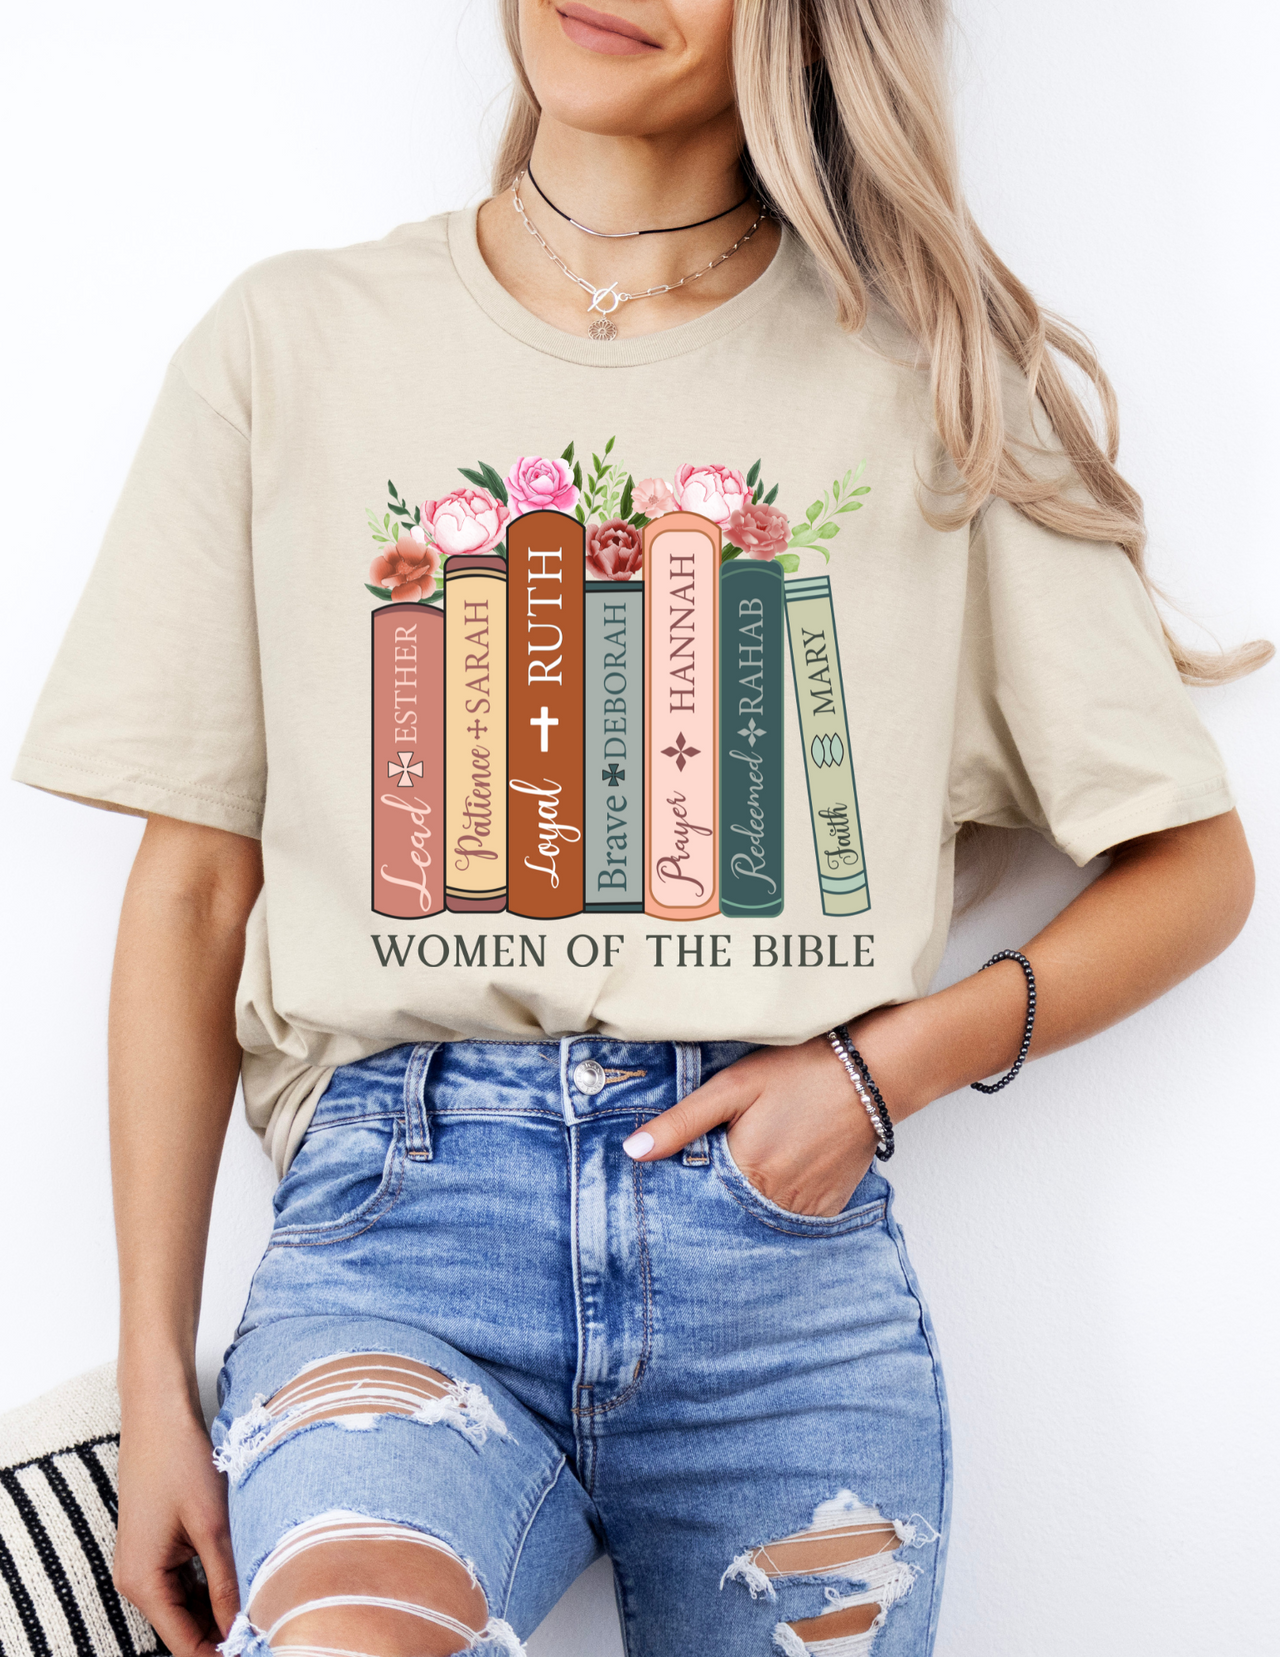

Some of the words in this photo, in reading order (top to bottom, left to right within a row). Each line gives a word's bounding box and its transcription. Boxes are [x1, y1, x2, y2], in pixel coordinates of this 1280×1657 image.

[464, 600, 490, 713] SARAH
[527, 547, 562, 685] RUTH
[670, 554, 695, 713] HANNAH
[739, 598, 763, 715] RAHAB
[801, 629, 837, 716] MARY
[395, 624, 417, 743] ESTHER
[604, 603, 626, 759] DEBORAH
[380, 795, 432, 912] Lead
[454, 745, 498, 871] Patience
[509, 778, 581, 888] Loyal
[598, 796, 627, 891] Brave
[656, 791, 713, 897] Prayer
[729, 750, 776, 894] Redeemed
[824, 801, 860, 870] Faith
[371, 934, 546, 967] WOMEN
[567, 934, 624, 967] OF
[646, 935, 730, 967] THE
[753, 935, 874, 967] BIBLE
